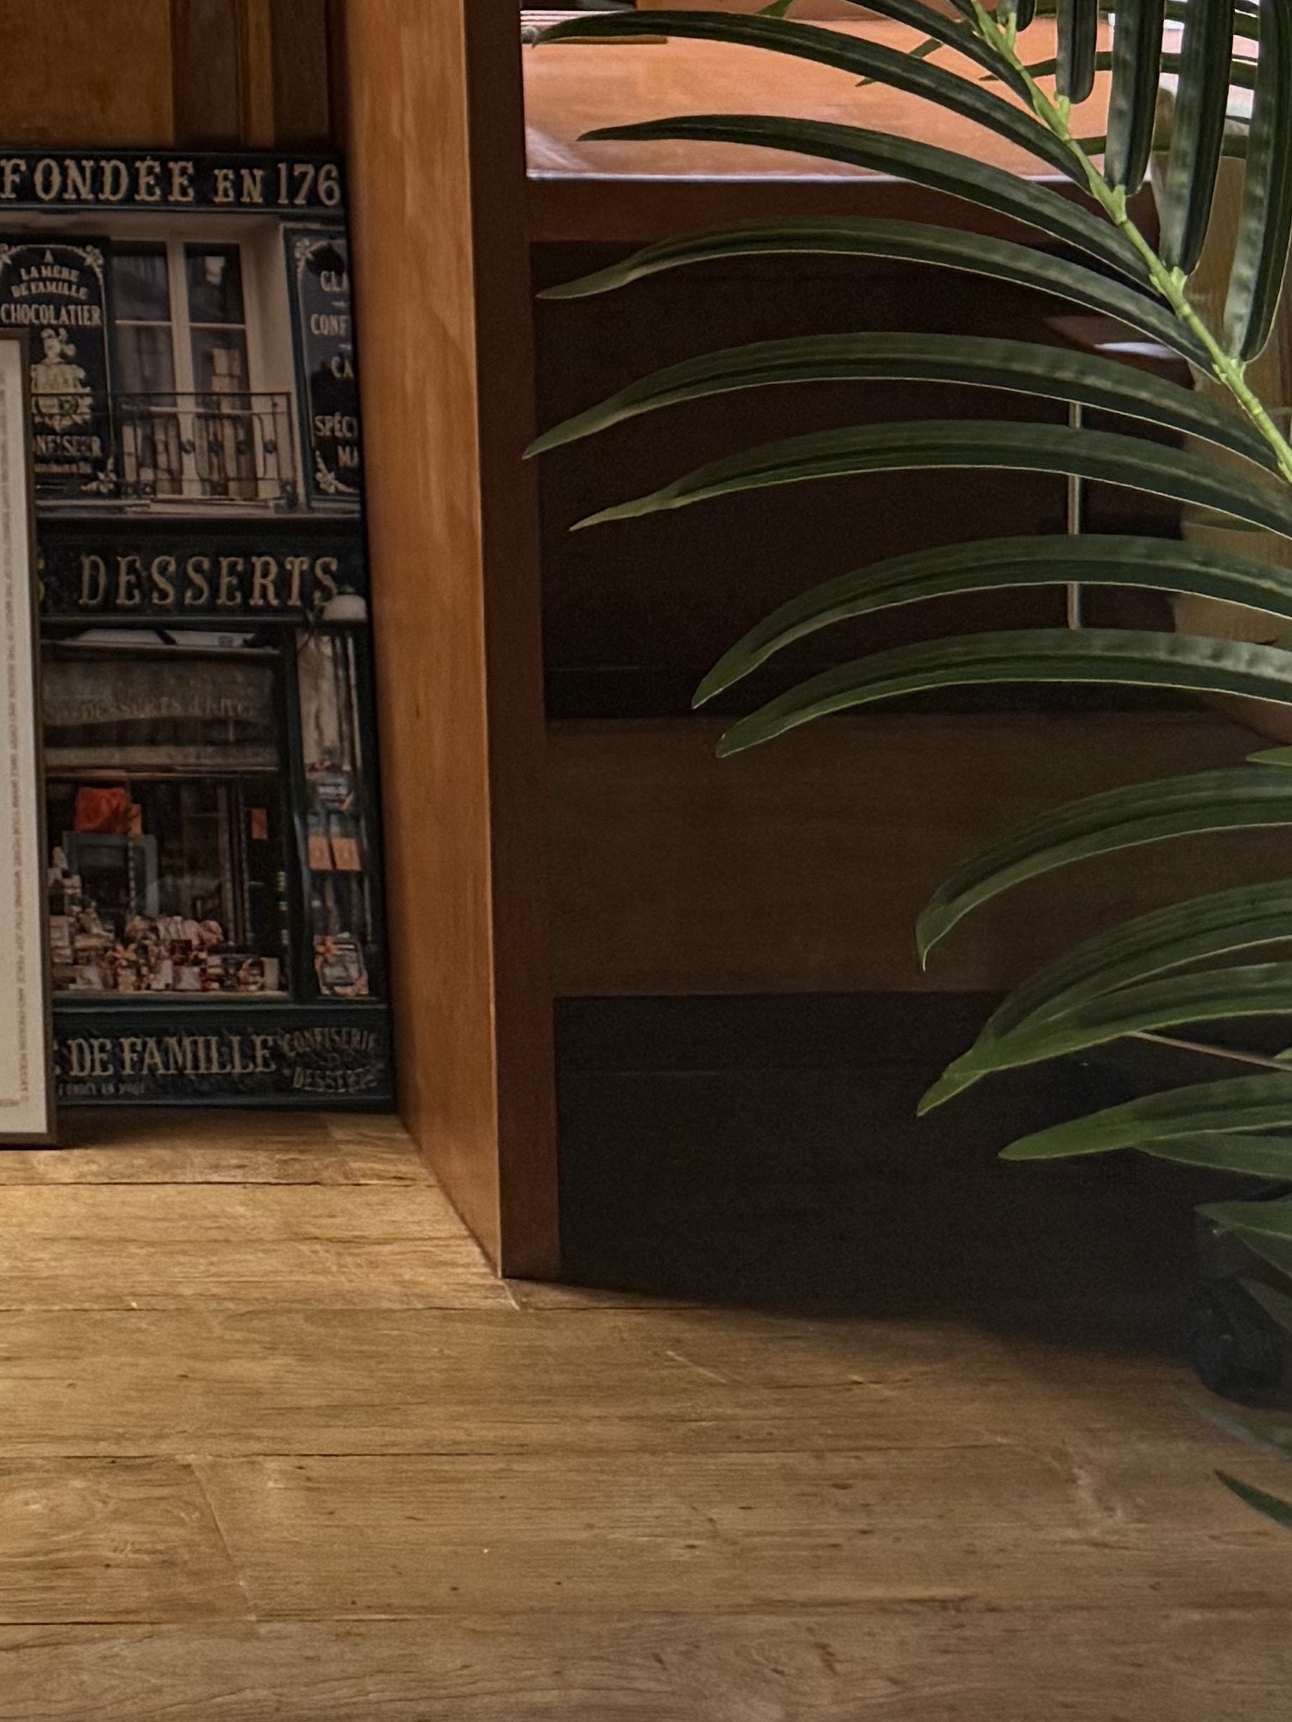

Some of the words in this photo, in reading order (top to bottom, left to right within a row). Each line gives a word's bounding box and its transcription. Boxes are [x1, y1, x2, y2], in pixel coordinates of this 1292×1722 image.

[212, 168, 265, 204] EN
[19, 265, 40, 281] LA
[30, 280, 90, 301] FAMILLE
[0, 303, 103, 327] CHOCOLATIER
[78, 553, 338, 608] DESSERTS
[67, 1037, 114, 1077] DE
[119, 1033, 277, 1076] FAMILLE
